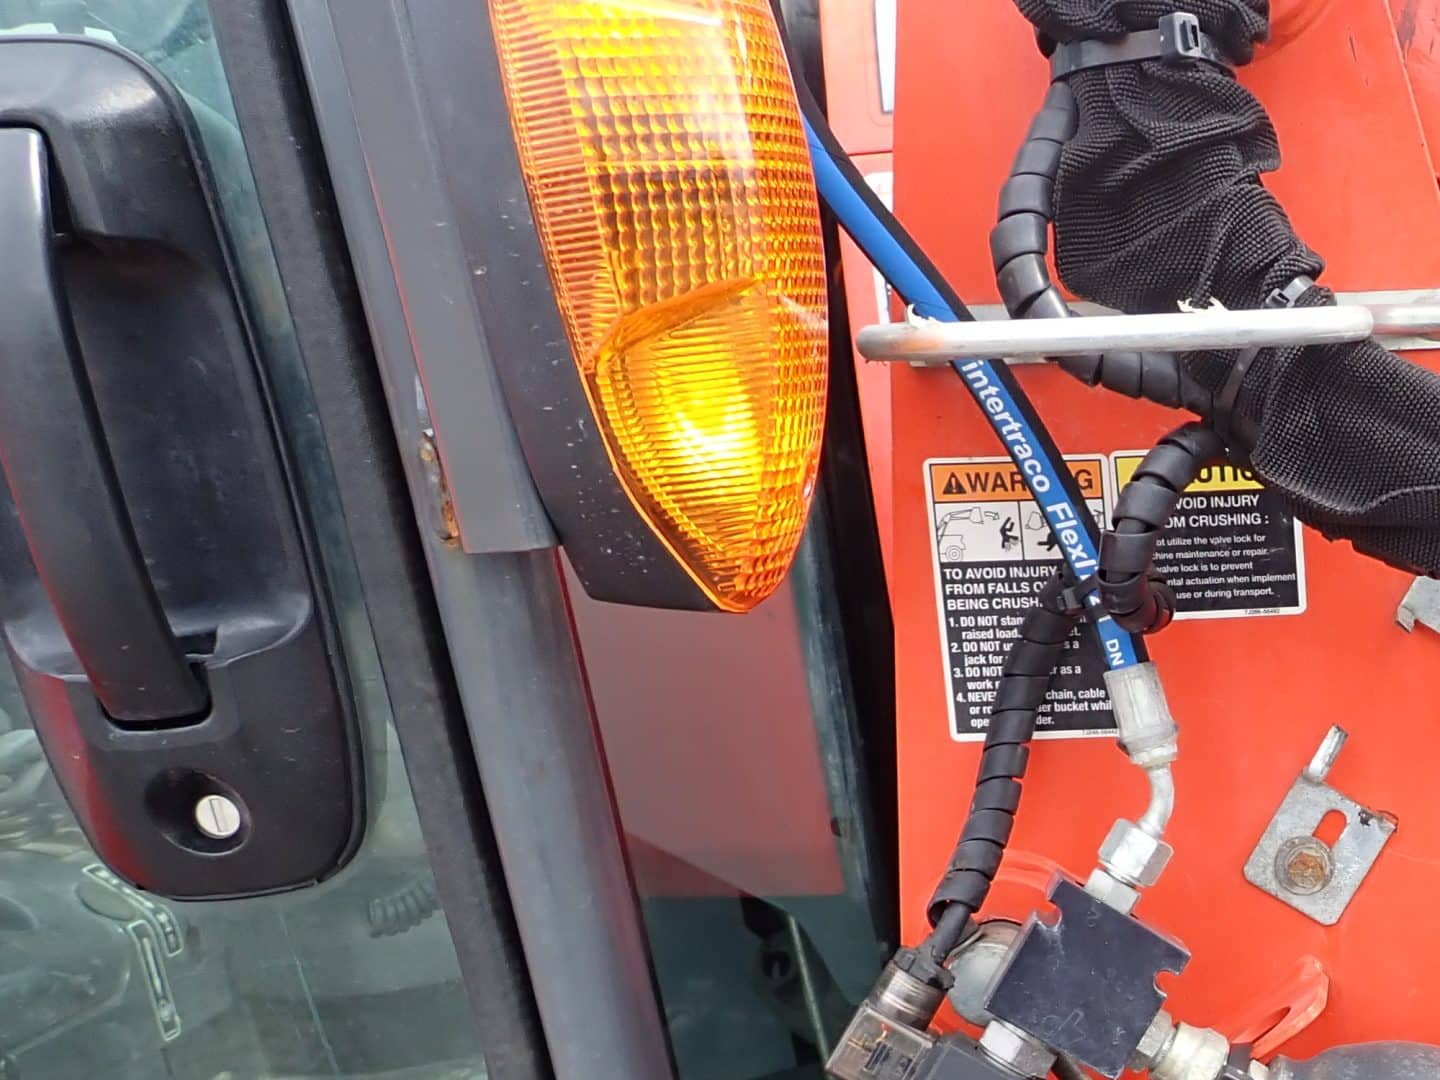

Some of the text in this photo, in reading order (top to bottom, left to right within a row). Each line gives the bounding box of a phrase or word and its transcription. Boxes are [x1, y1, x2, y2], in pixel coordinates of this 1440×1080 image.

[961, 360, 1050, 493] intertraco
[965, 469, 1094, 493] WARG
[1175, 494, 1260, 510] VOID INJURY
[1164, 514, 1187, 528] OM
[1189, 513, 1262, 527] CRUSHING
[1167, 536, 1193, 546] utilize
[1194, 535, 1208, 545] the
[1209, 535, 1232, 546] valve
[1233, 534, 1251, 543] lock
[1253, 533, 1266, 542] for
[1175, 549, 1230, 560] maintenance
[1231, 549, 1241, 557] or
[944, 566, 1057, 580] TO AVOID INJURY
[1180, 562, 1198, 572] lock
[1200, 562, 1208, 571] is
[1209, 562, 1219, 571] to
[1220, 561, 1253, 572] prevent
[1185, 575, 1226, 586] actuation
[1226, 574, 1249, 584] when
[1251, 572, 1296, 584] implement
[945, 581, 1048, 595] FROM FALLS O
[1176, 587, 1274, 600] use or during transport.
[947, 598, 989, 610] BEING
[960, 617, 975, 627] DO
[978, 616, 998, 626] NOT
[1000, 616, 1026, 626] stan
[962, 629, 994, 640] raised
[951, 642, 961, 653] 2.
[963, 642, 977, 652] DO
[980, 641, 1001, 651] NOT
[964, 653, 1003, 667] jack for
[953, 668, 963, 678] 3.
[965, 667, 980, 677] DO
[982, 666, 1003, 677] NOT
[1060, 666, 1072, 674] as
[967, 679, 994, 690] work
[956, 693, 966, 703] 4.
[1045, 689, 1077, 702] chain,
[1078, 688, 1106, 699] cable
[969, 706, 980, 715] or
[1054, 701, 1089, 712] bucket
[1091, 700, 1113, 711] whil
